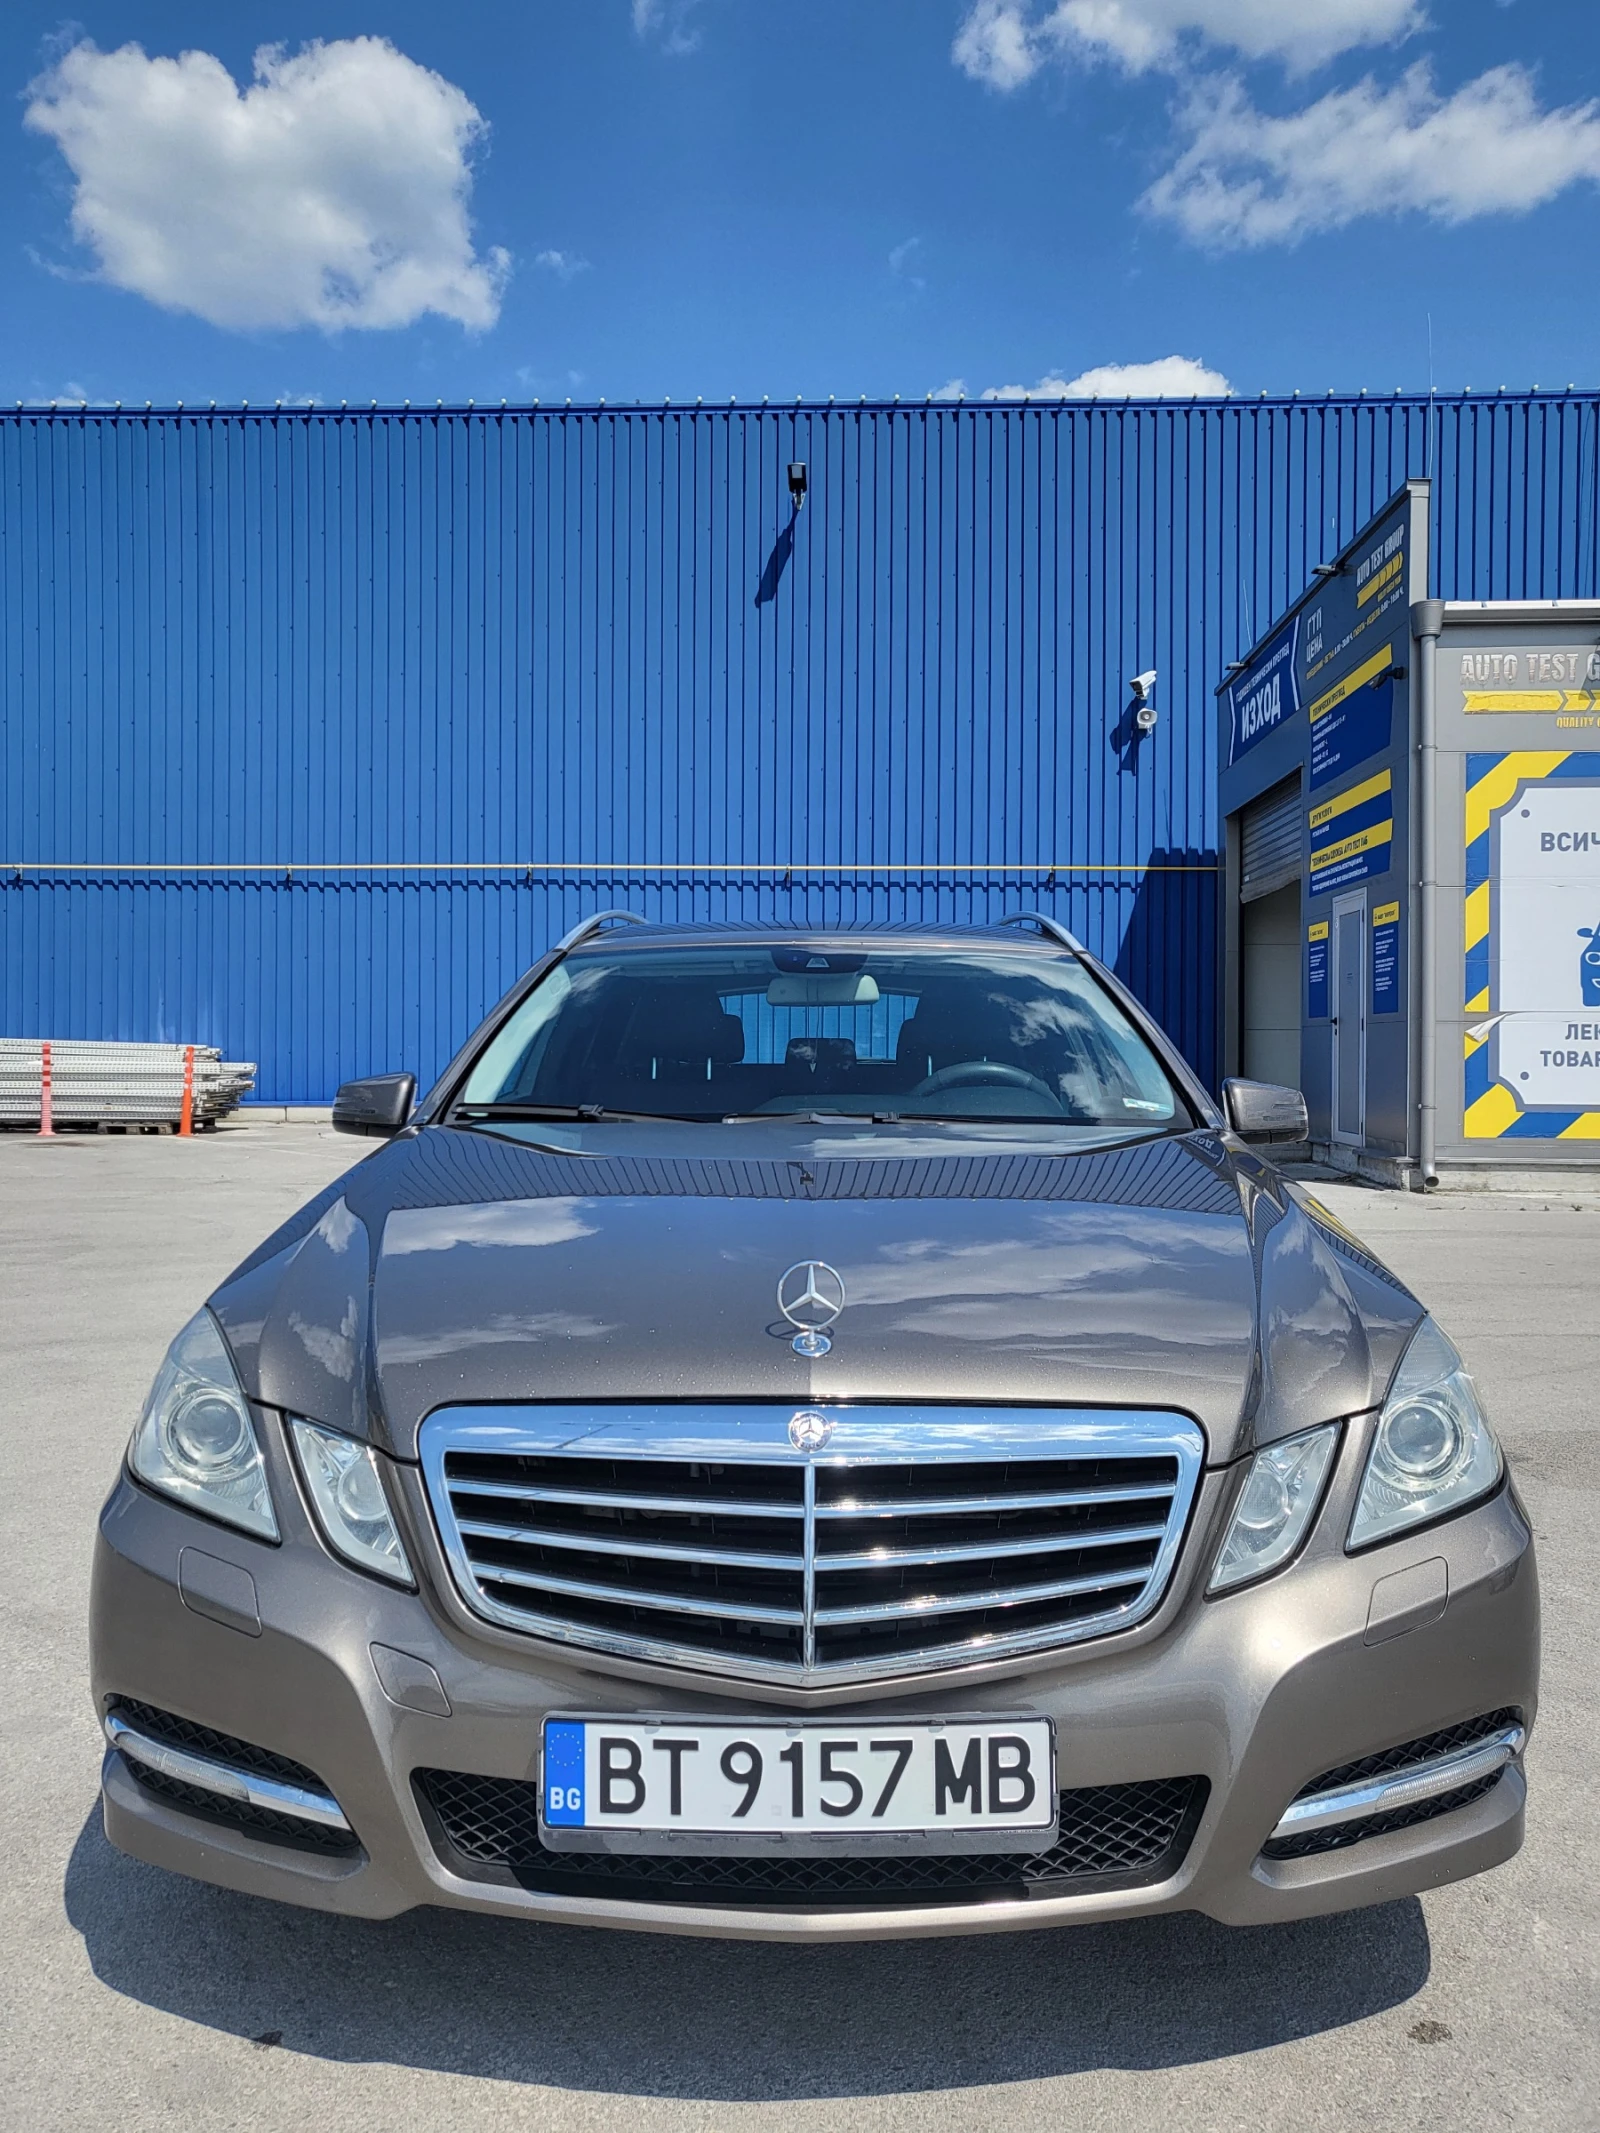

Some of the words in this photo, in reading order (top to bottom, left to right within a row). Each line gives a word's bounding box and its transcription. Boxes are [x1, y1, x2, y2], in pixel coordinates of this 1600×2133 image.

[1357, 558, 1370, 588] AUTO
[1371, 544, 1384, 573] TEST
[1384, 523, 1404, 559] GROUP
[1307, 606, 1322, 640] ГТП
[1305, 632, 1323, 664] ЦЕНА
[1461, 654, 1518, 683] AUTO
[1526, 653, 1579, 683] TEST
[1241, 672, 1281, 743] ИЗХОД
[1556, 716, 1594, 728] QUALITY
[600, 1737, 699, 1815] BT
[720, 1739, 913, 1817] 9157
[934, 1736, 1036, 1815] MB
[550, 1786, 582, 1811] BG
